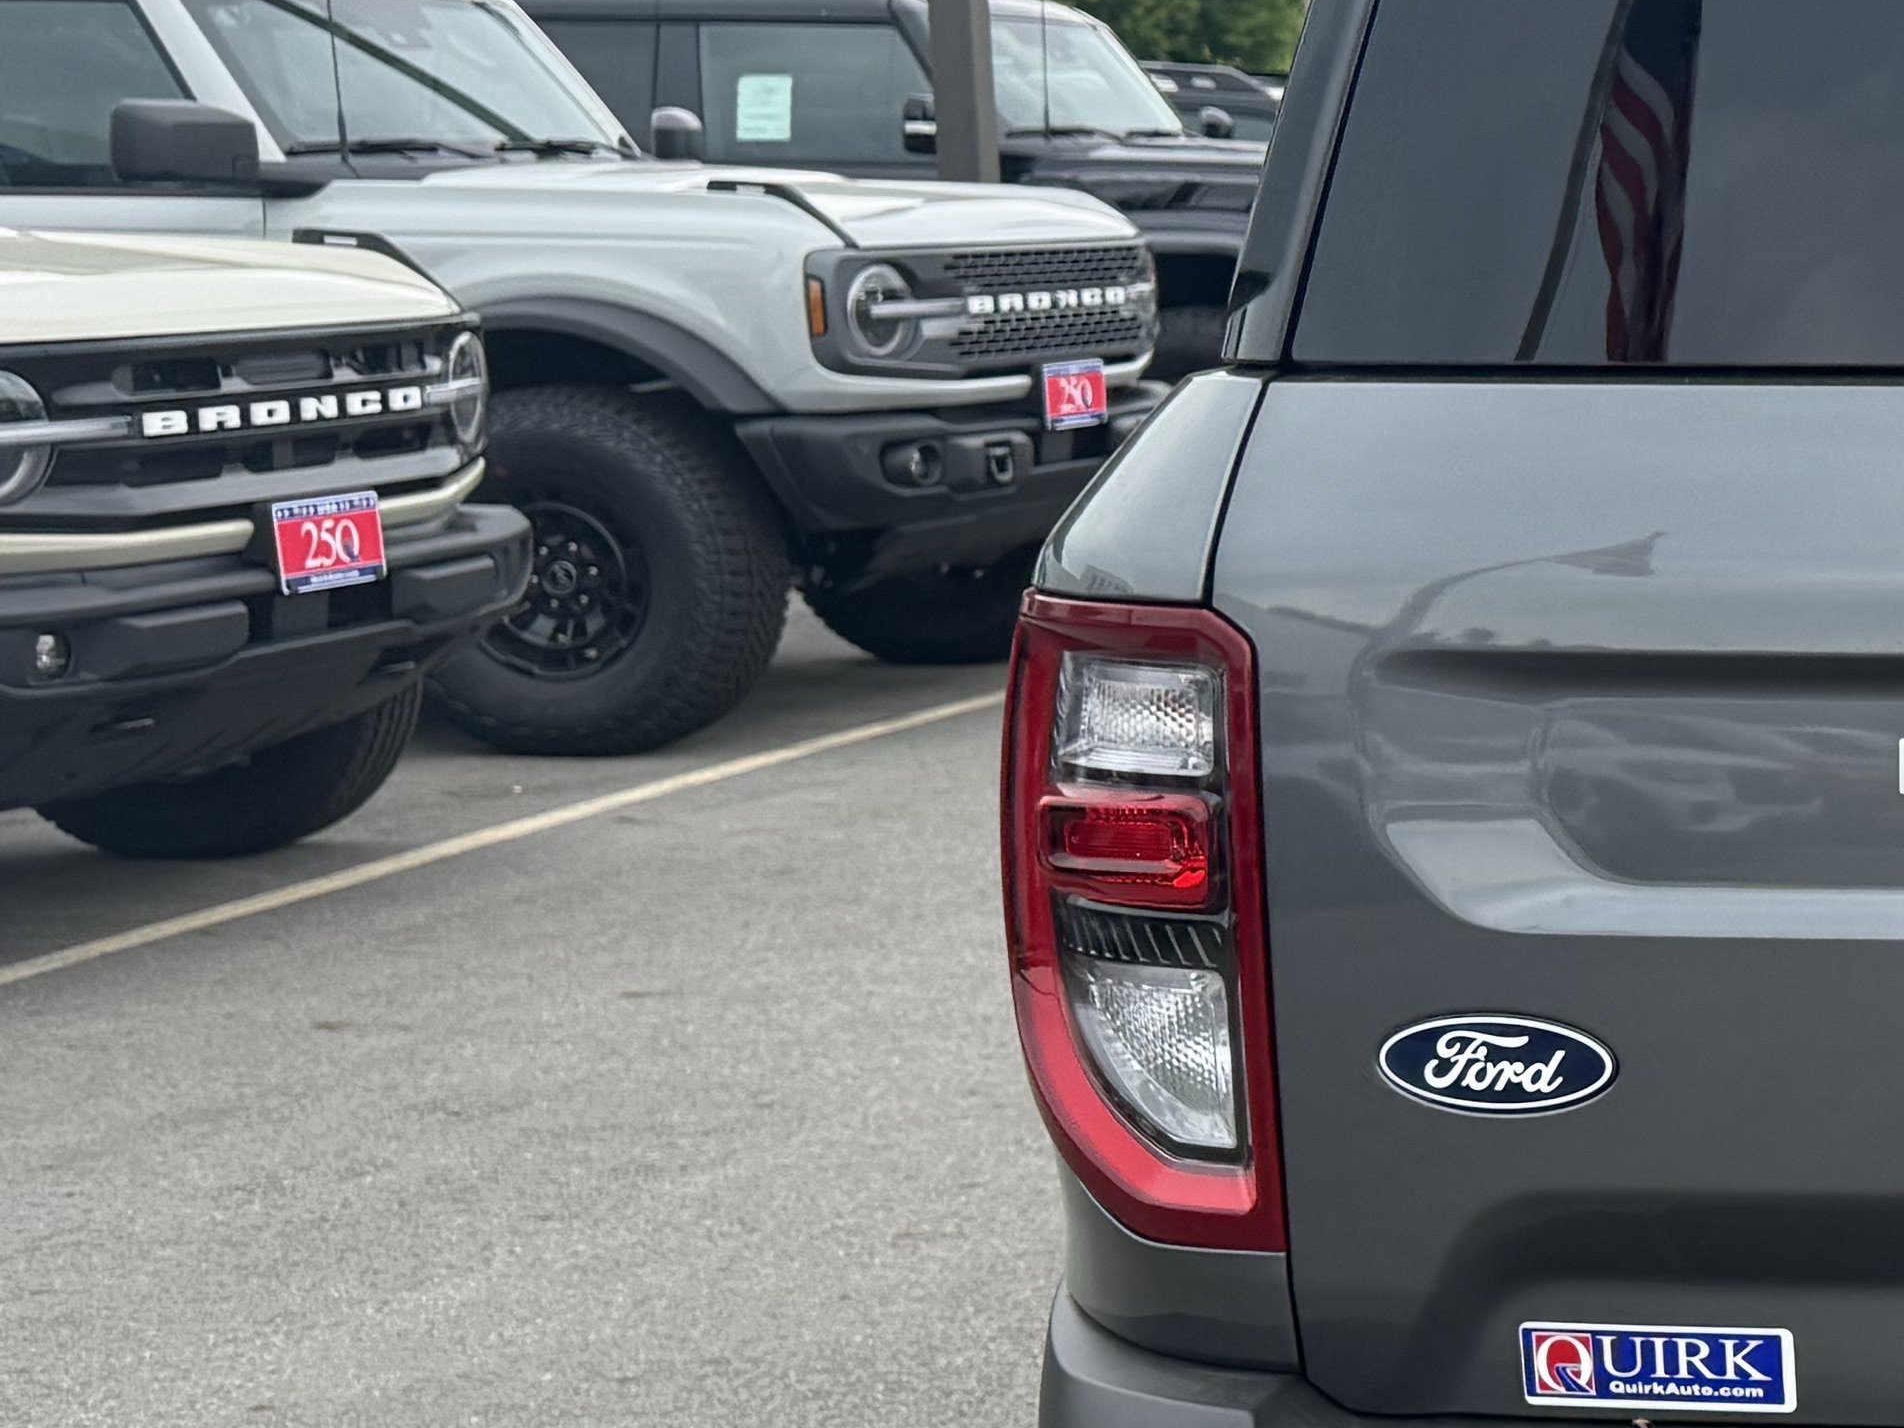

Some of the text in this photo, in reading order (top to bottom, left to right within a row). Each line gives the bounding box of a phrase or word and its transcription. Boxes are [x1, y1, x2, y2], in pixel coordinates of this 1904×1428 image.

[142, 385, 422, 437] BRONCO
[300, 518, 360, 569] 250
[1423, 1029, 1565, 1094] Ford
[1535, 1332, 1773, 1394] QUIRK
[1608, 1380, 1765, 1399] QuirkAuto.com
